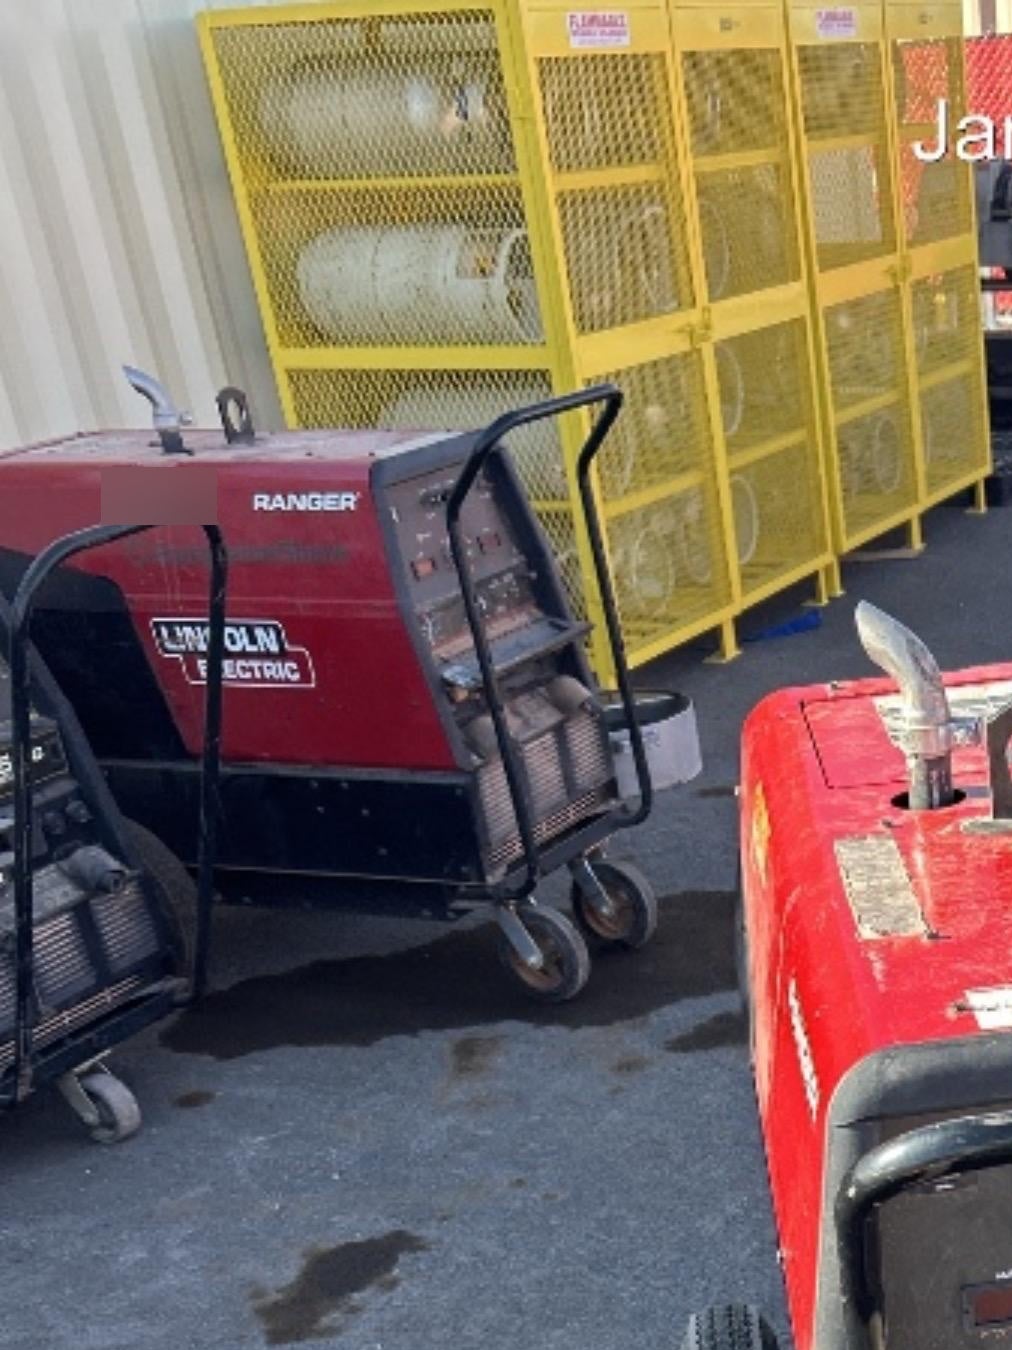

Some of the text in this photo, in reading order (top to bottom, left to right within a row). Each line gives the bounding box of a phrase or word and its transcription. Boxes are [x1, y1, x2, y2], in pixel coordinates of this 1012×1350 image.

[253, 493, 358, 512] RANGER
[159, 626, 281, 653] LINOLN
[196, 659, 301, 681] EECTRIC
